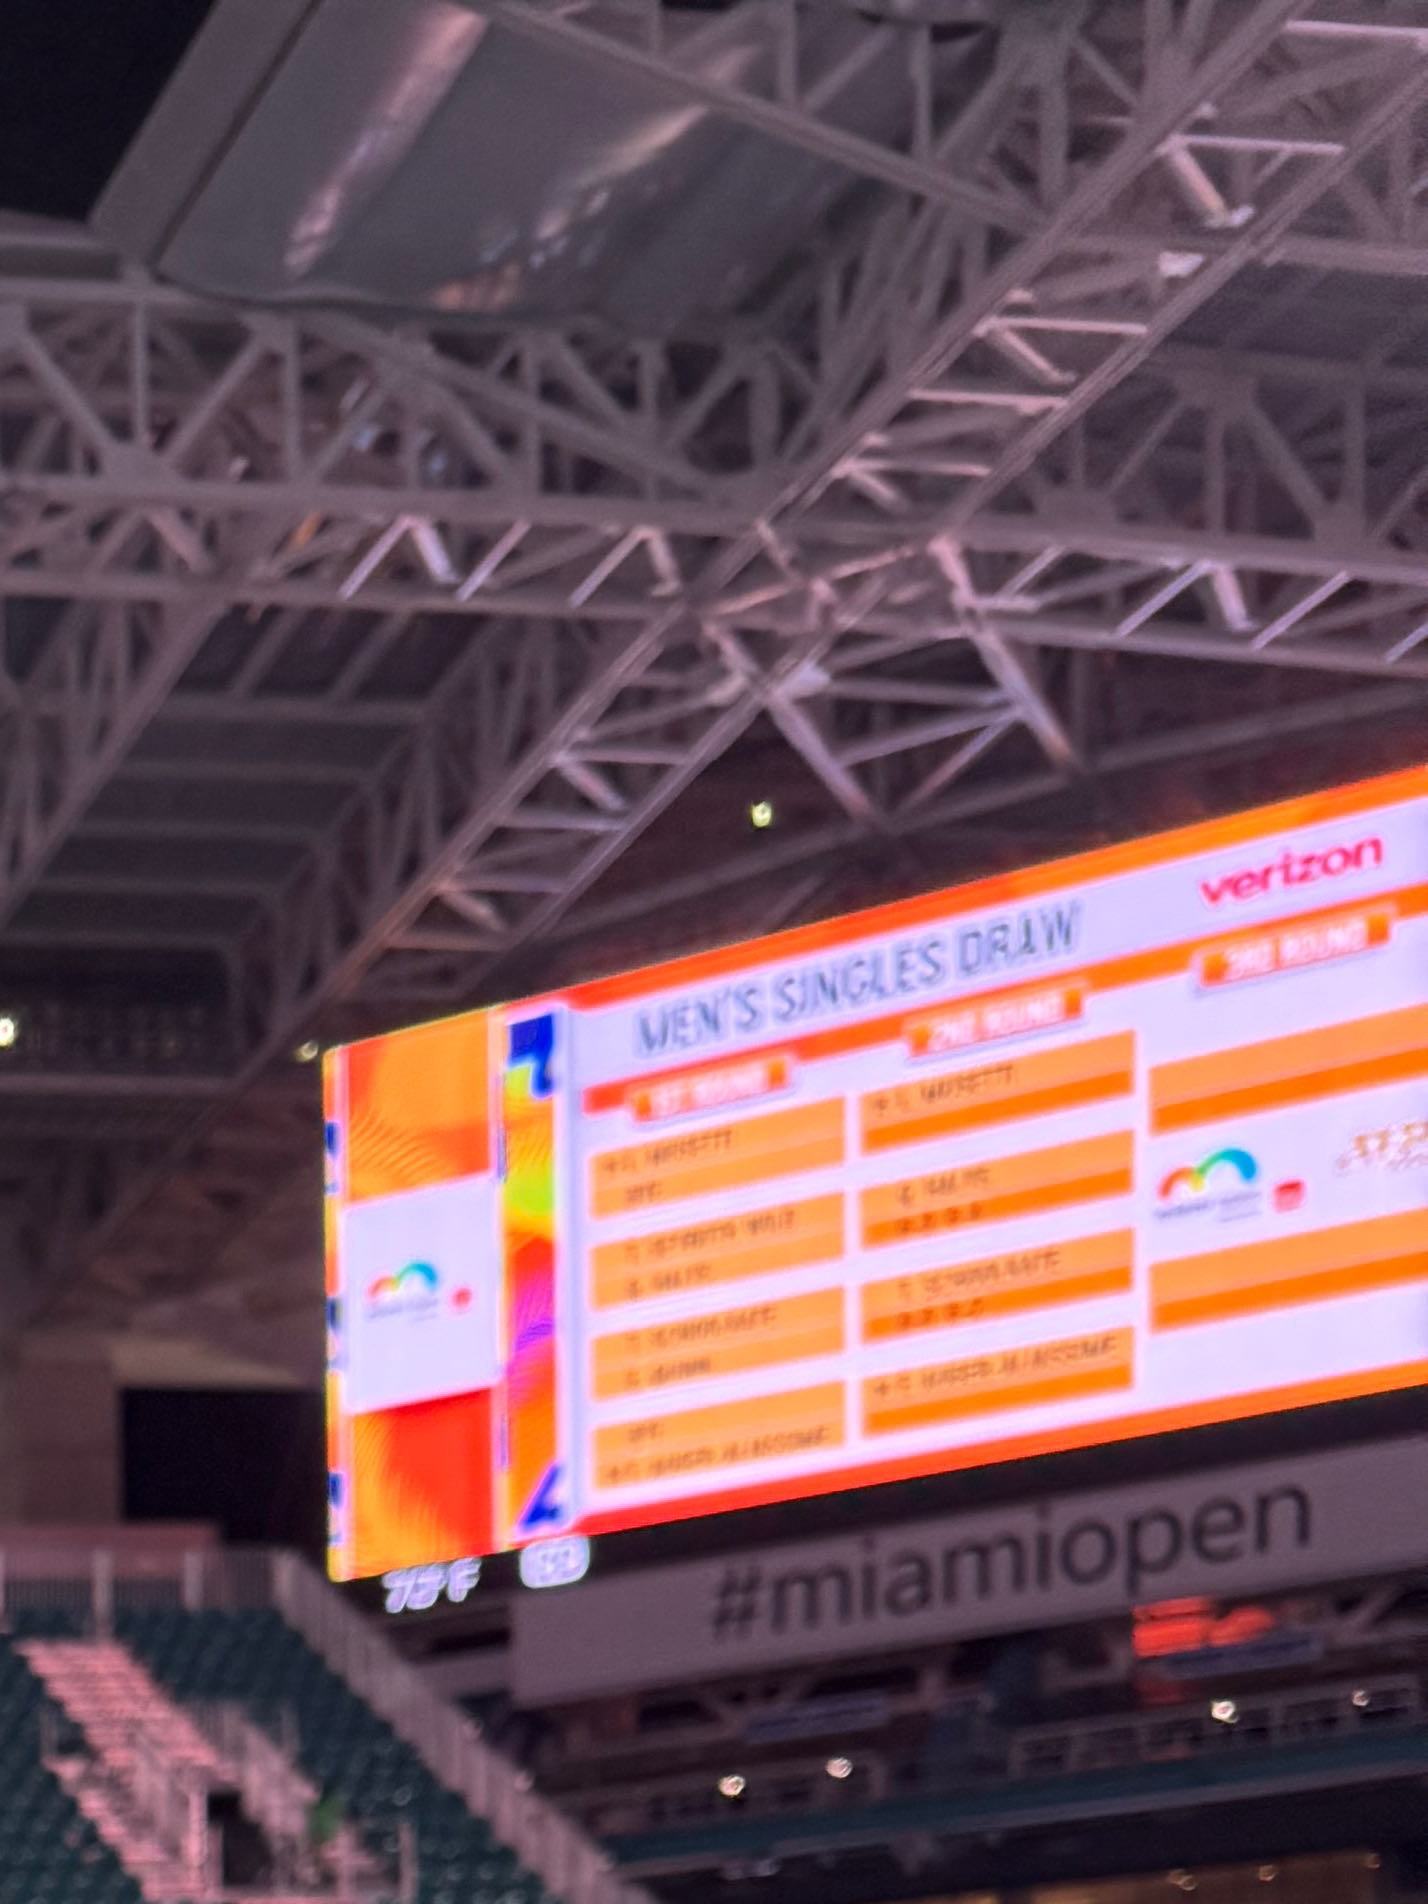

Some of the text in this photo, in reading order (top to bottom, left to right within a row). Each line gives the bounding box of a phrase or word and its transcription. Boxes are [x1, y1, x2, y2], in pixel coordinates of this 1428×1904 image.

[1200, 837, 1383, 904] verizon
[638, 902, 1081, 1053] MEN'S SINGLES DRAW
[711, 1483, 1313, 1640] #miamiopen
